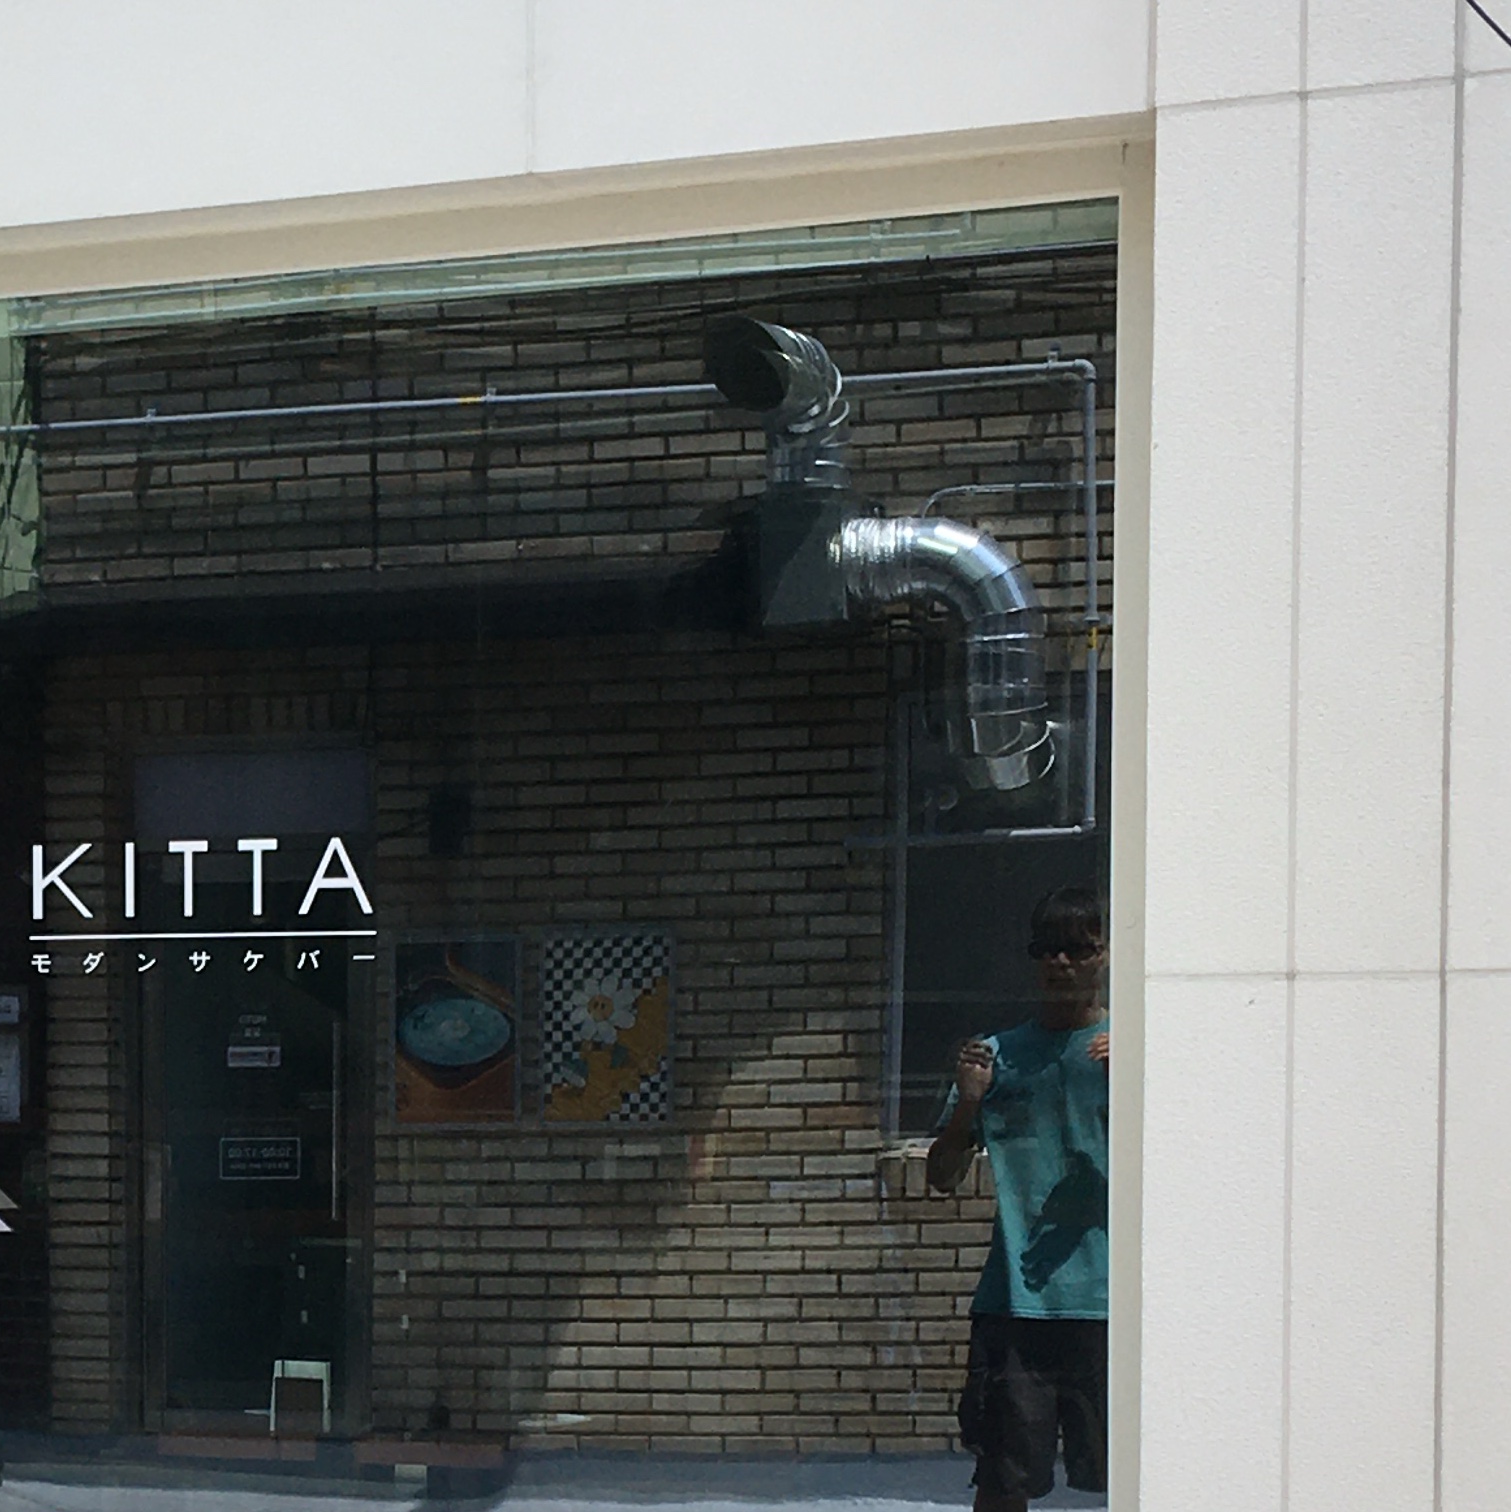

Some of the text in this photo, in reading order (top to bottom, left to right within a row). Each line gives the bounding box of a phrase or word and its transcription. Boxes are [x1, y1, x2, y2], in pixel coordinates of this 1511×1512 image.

[31, 836, 373, 920] KITTA
[30, 949, 376, 974] モダンサケバー
